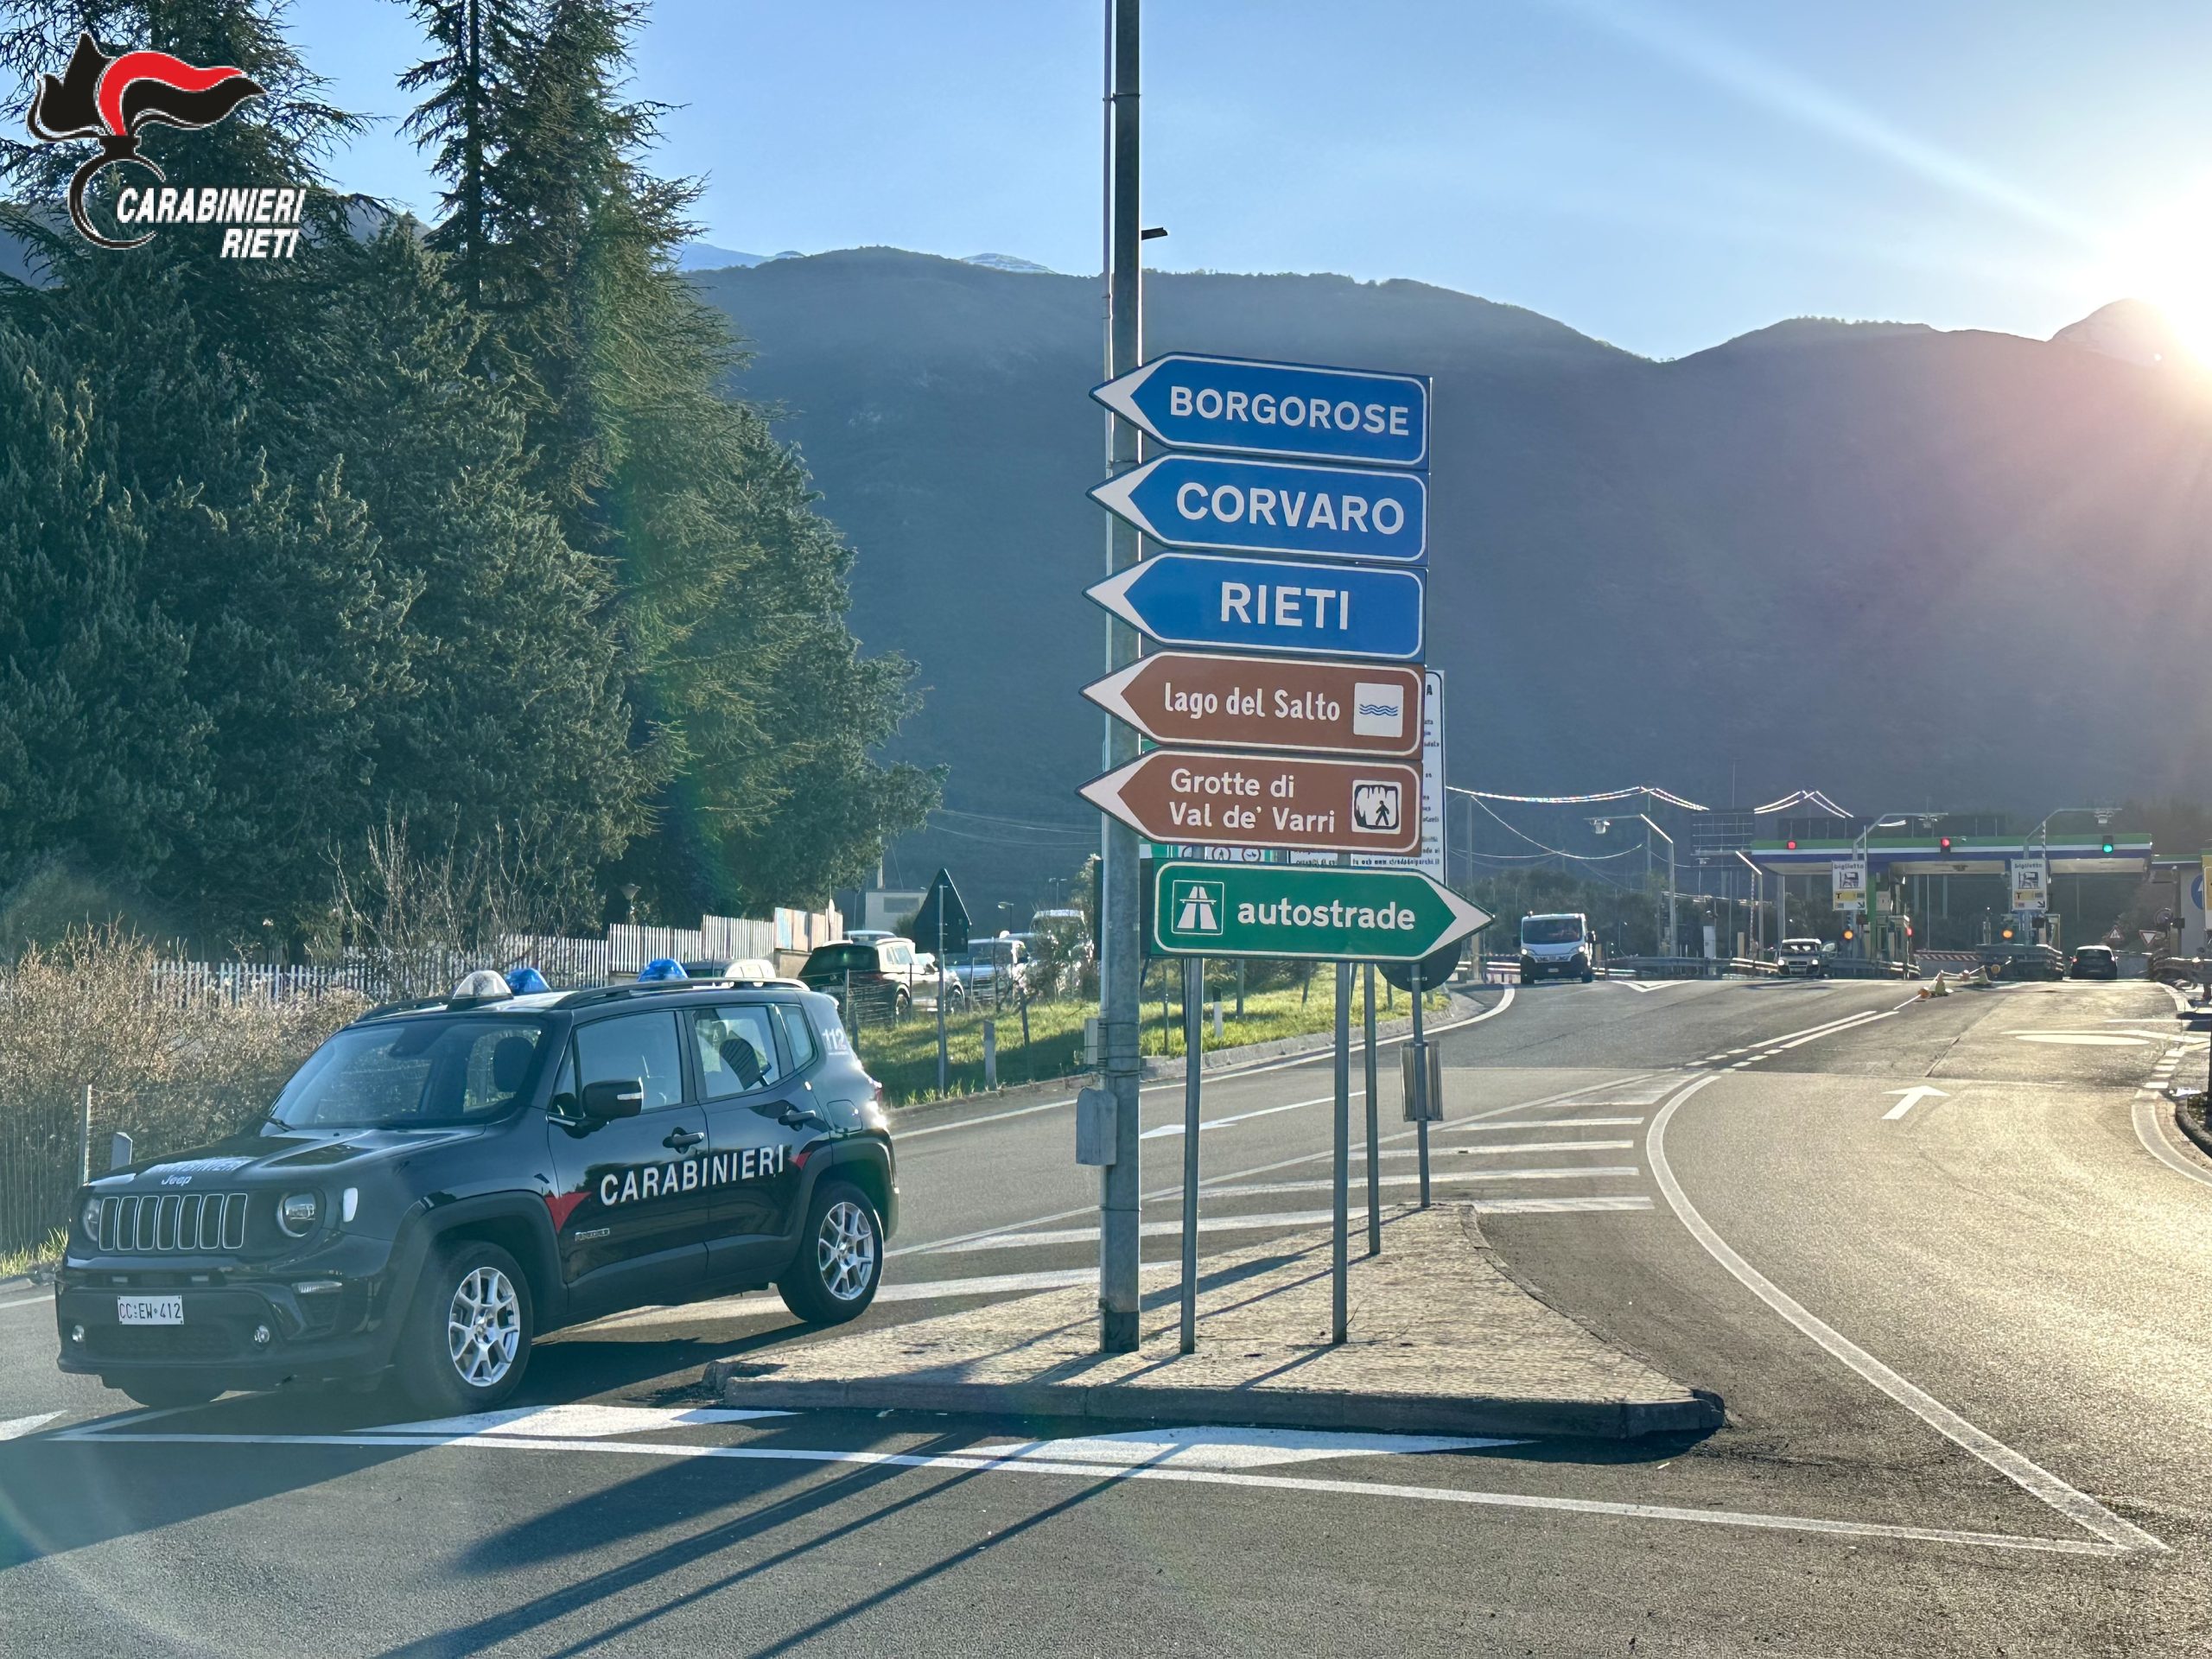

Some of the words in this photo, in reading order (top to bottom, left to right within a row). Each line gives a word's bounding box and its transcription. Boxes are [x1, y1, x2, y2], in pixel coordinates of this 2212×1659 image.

[1170, 385, 1409, 435] BORGOROSE
[1176, 482, 1404, 535] CORVARO
[1220, 582, 1349, 630] RIETI
[1165, 682, 1217, 720] lago
[1225, 687, 1266, 717] del
[1274, 689, 1340, 721] Salto
[1171, 767, 1261, 797] Grotte
[1269, 774, 1294, 798] di
[1169, 801, 1212, 828] Val
[1223, 804, 1262, 830] de'
[1272, 806, 1335, 833] Varri
[1237, 897, 1415, 931] autostrade
[822, 1027, 848, 1051] 112
[161, 1174, 193, 1186] Jeep
[601, 1144, 784, 1206] CARABINIERI
